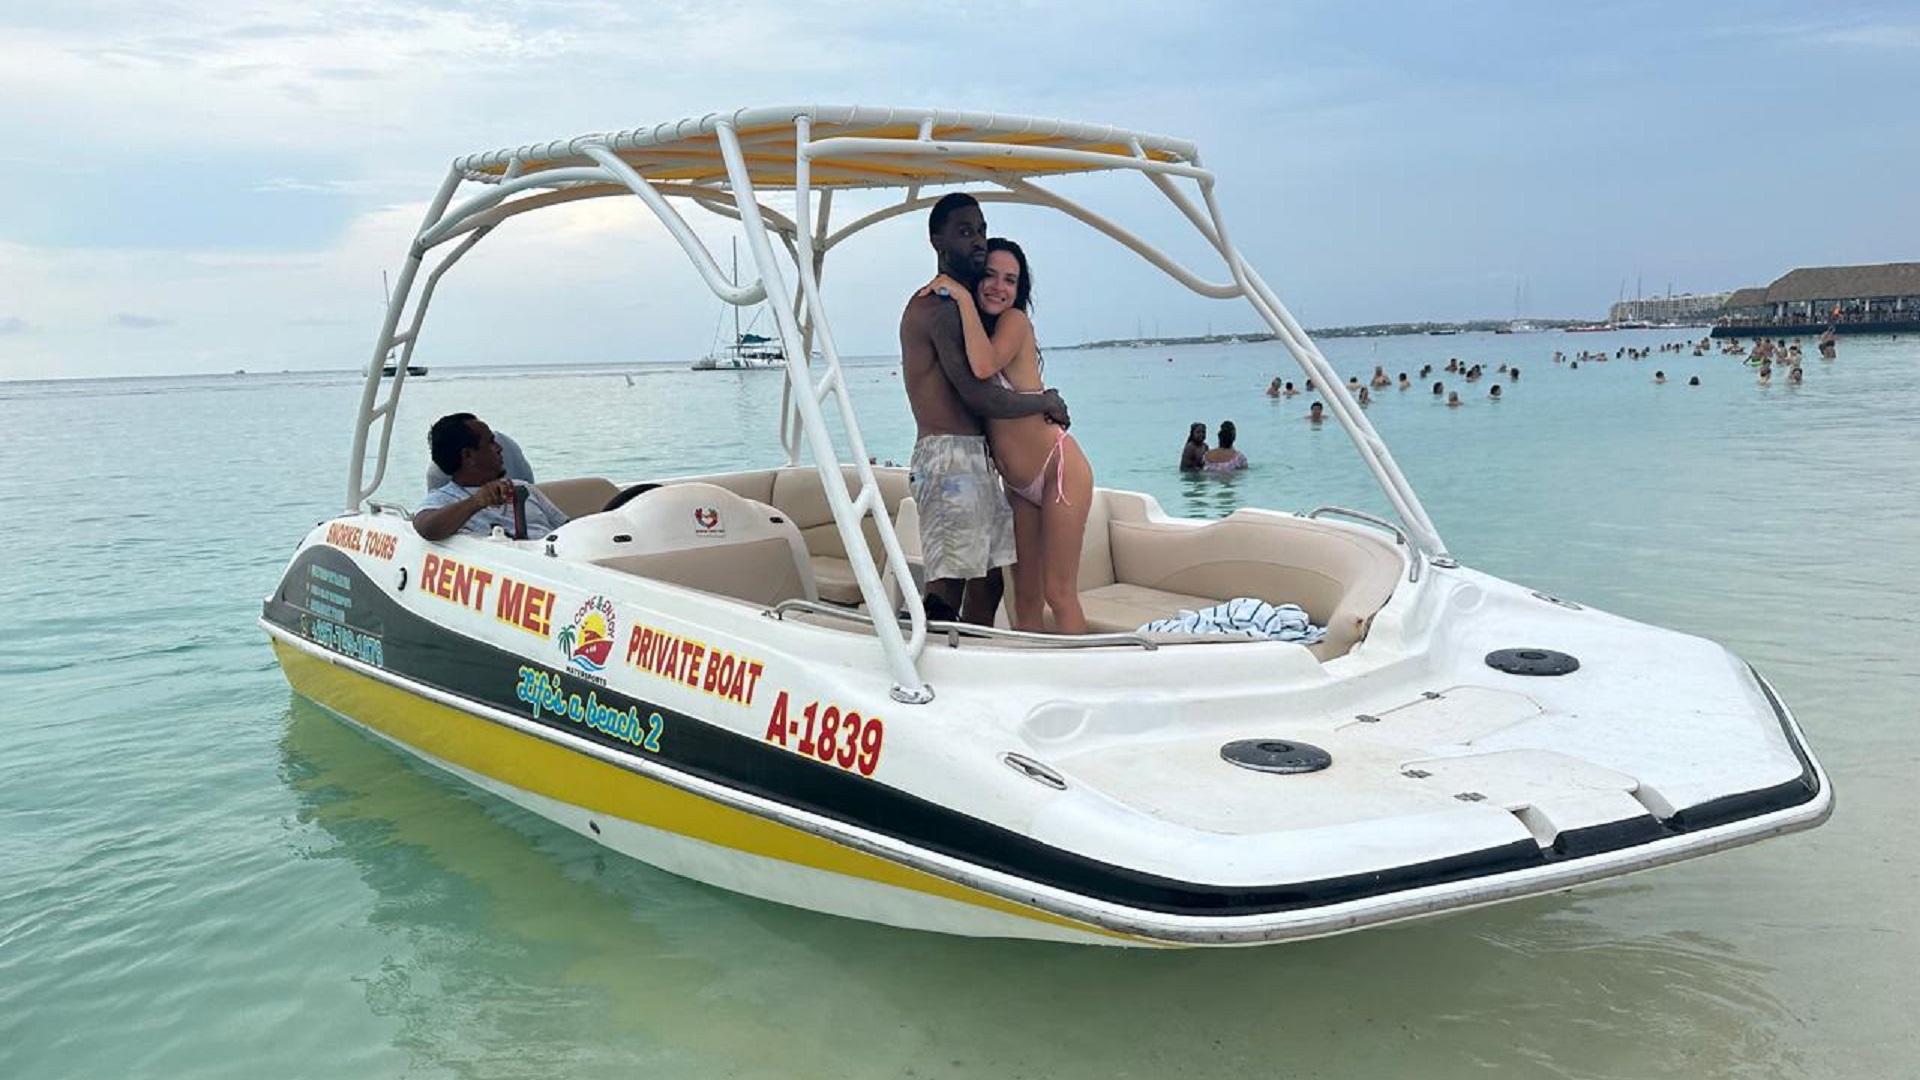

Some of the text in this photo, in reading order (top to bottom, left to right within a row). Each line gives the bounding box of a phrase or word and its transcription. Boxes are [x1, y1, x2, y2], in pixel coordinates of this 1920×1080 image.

[363, 530, 398, 560] TOURS
[420, 552, 493, 611] RENT
[496, 577, 556, 636] ME!
[574, 595, 597, 625] COME
[602, 600, 615, 638] ENJOY
[565, 666, 607, 686] WATERSPORTS
[626, 624, 764, 705] PRIVATE BOAT
[516, 665, 664, 752] Life's a beach 2
[765, 690, 884, 776] A-1839
